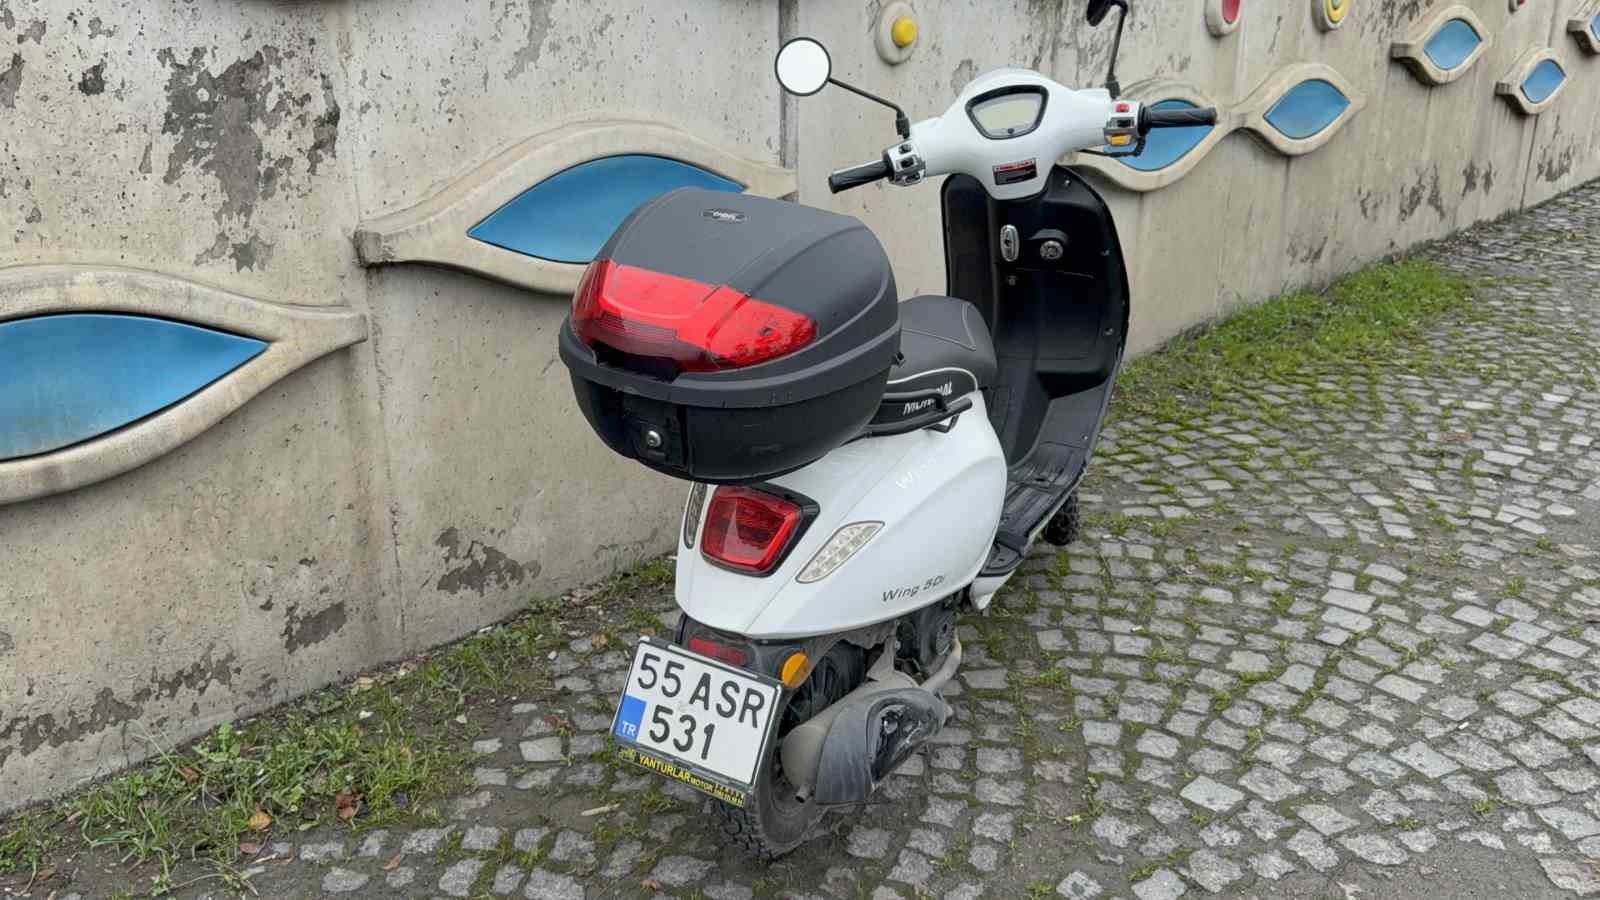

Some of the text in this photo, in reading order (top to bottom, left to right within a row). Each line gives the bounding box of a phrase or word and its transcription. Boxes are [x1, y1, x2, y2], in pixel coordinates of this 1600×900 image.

[882, 585, 920, 602] Wing
[637, 653, 765, 729] 55 ASR
[622, 720, 637, 736] TR
[649, 704, 715, 761] 531
[638, 754, 714, 792] YANTURLAR MOTOR
